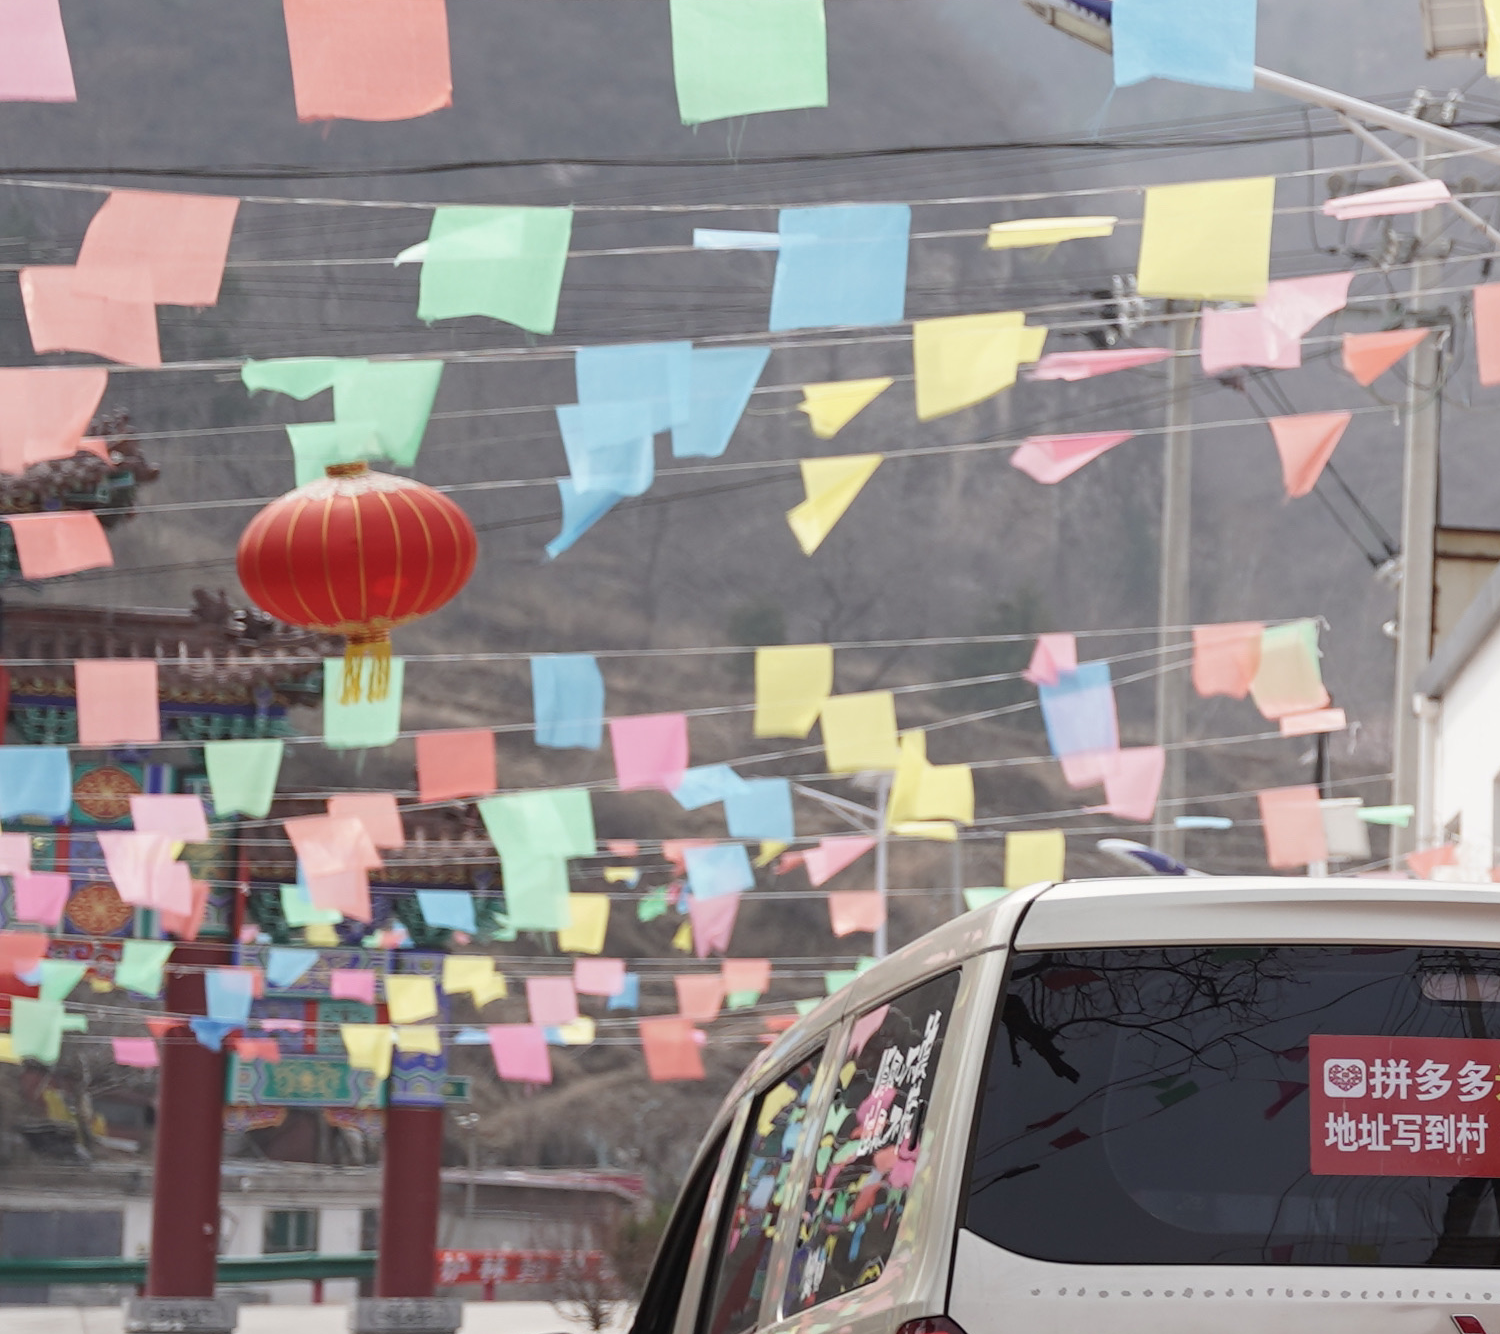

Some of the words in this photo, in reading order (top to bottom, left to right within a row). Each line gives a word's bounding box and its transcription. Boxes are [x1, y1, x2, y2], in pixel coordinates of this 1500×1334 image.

[1325, 1112, 1489, 1154] 地址写到村
